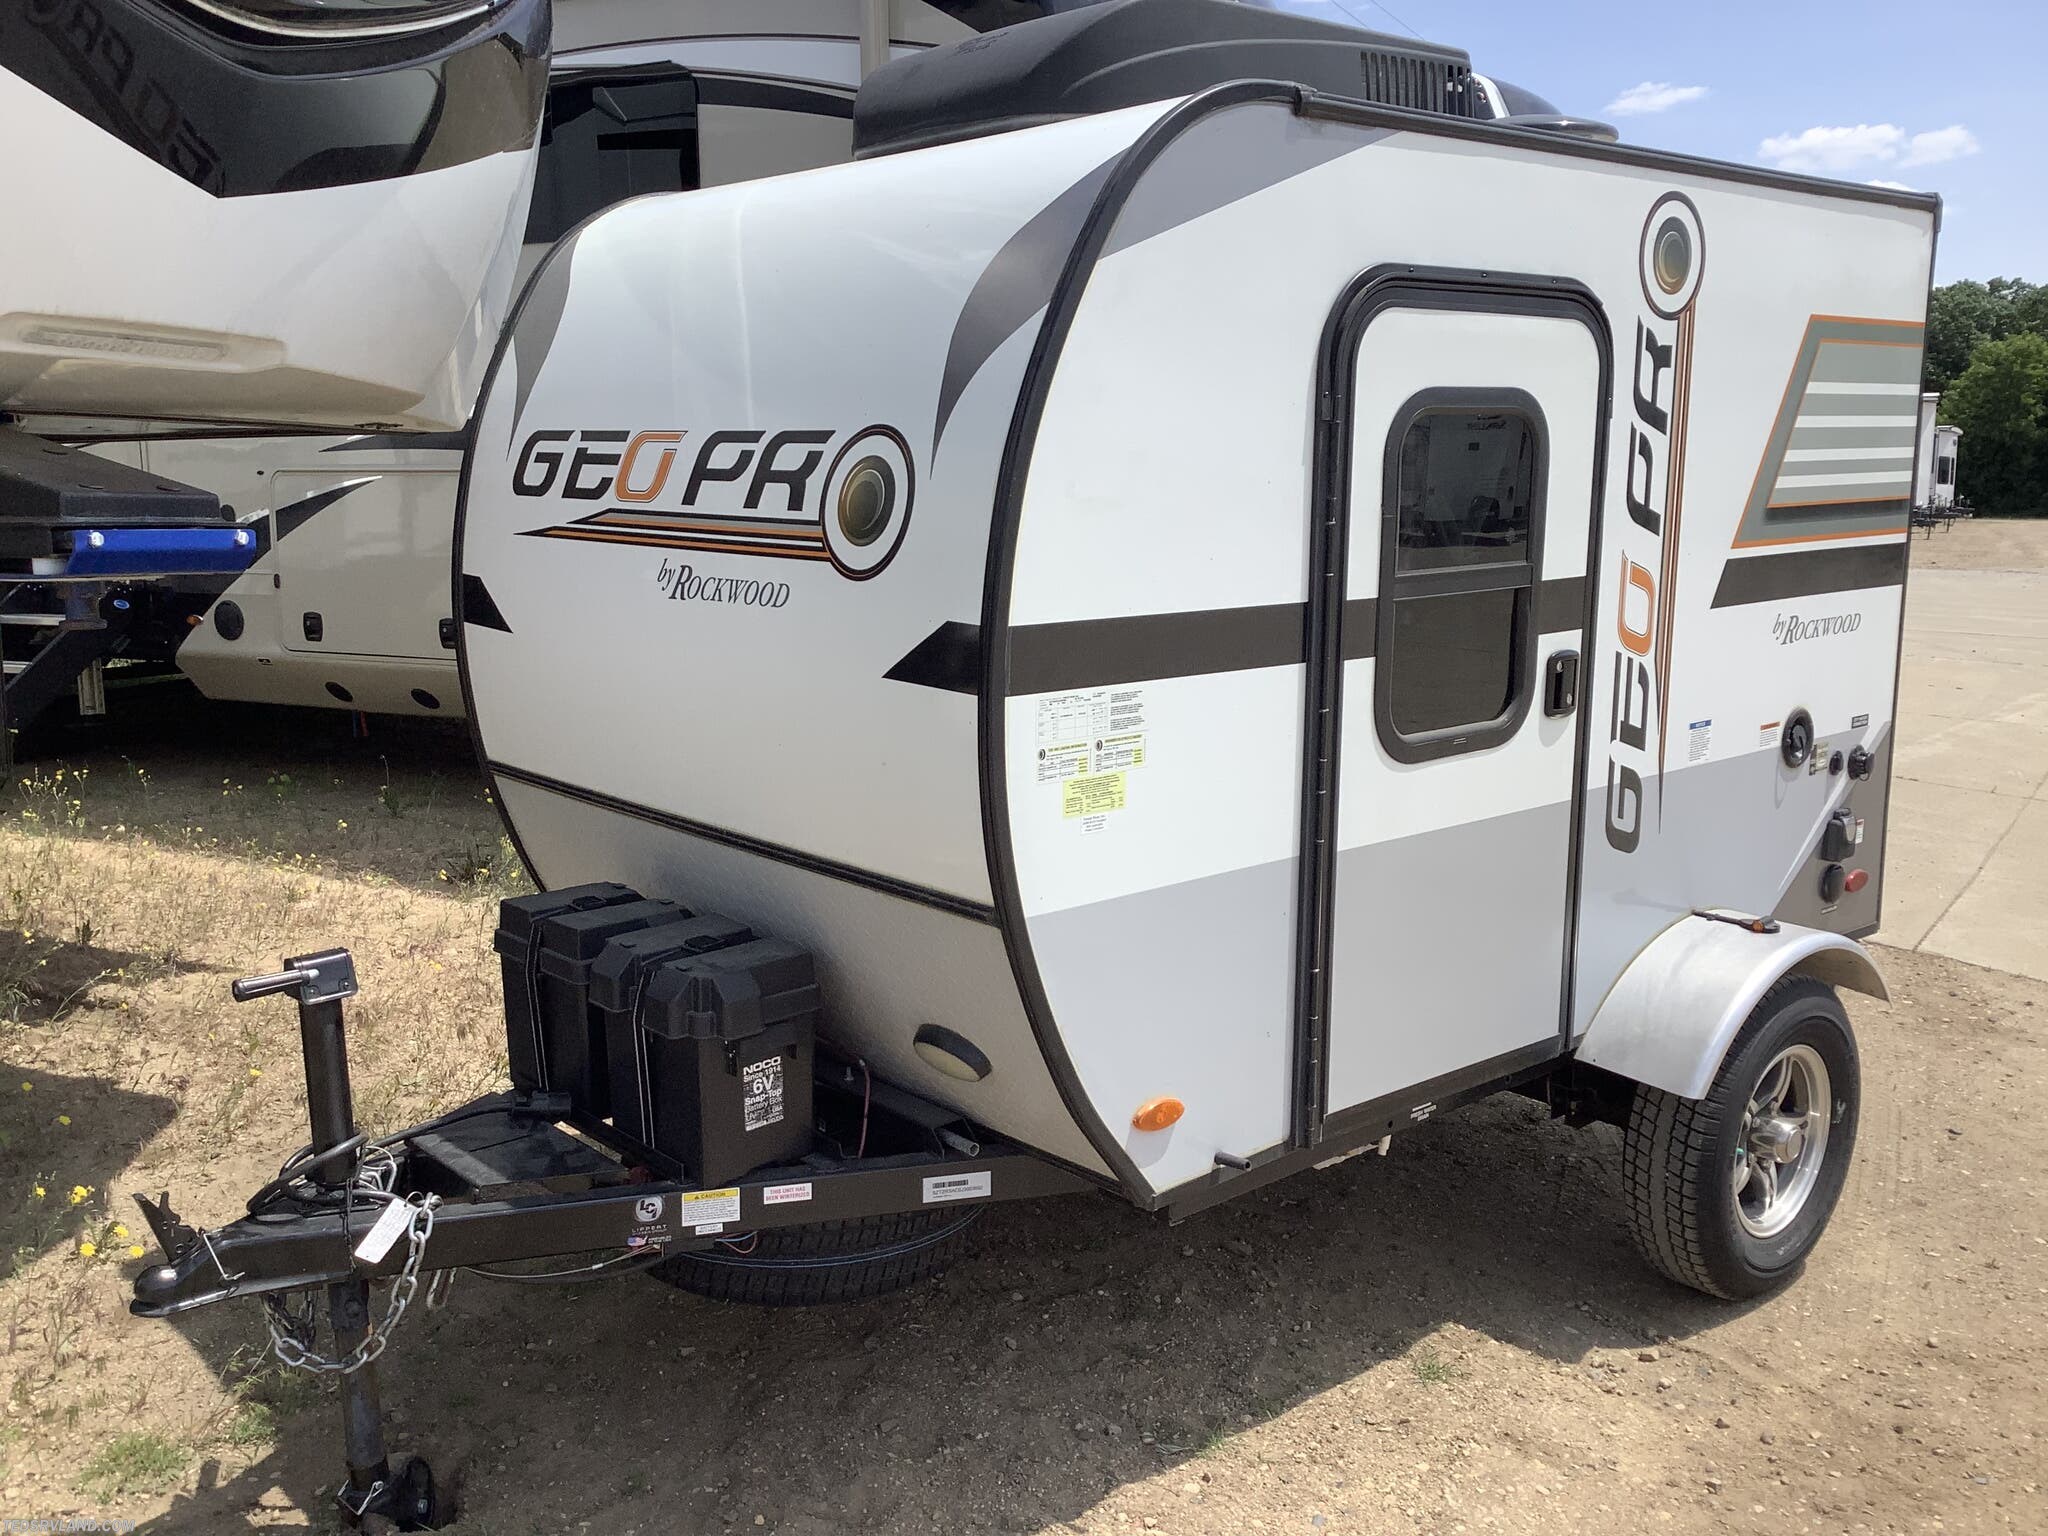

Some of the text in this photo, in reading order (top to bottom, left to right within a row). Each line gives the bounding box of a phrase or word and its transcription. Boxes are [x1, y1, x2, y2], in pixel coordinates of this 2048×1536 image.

[513, 423, 916, 582] GEO PRO
[657, 558, 676, 591] by
[1772, 613, 1788, 641] by
[1605, 549, 1656, 854] GEO
[743, 1056, 781, 1075] NOCO
[744, 1066, 782, 1083] Since 1914
[753, 1074, 774, 1095] 6V
[745, 1089, 782, 1106] Snap-Top
[701, 1191, 726, 1200] CAUTION
